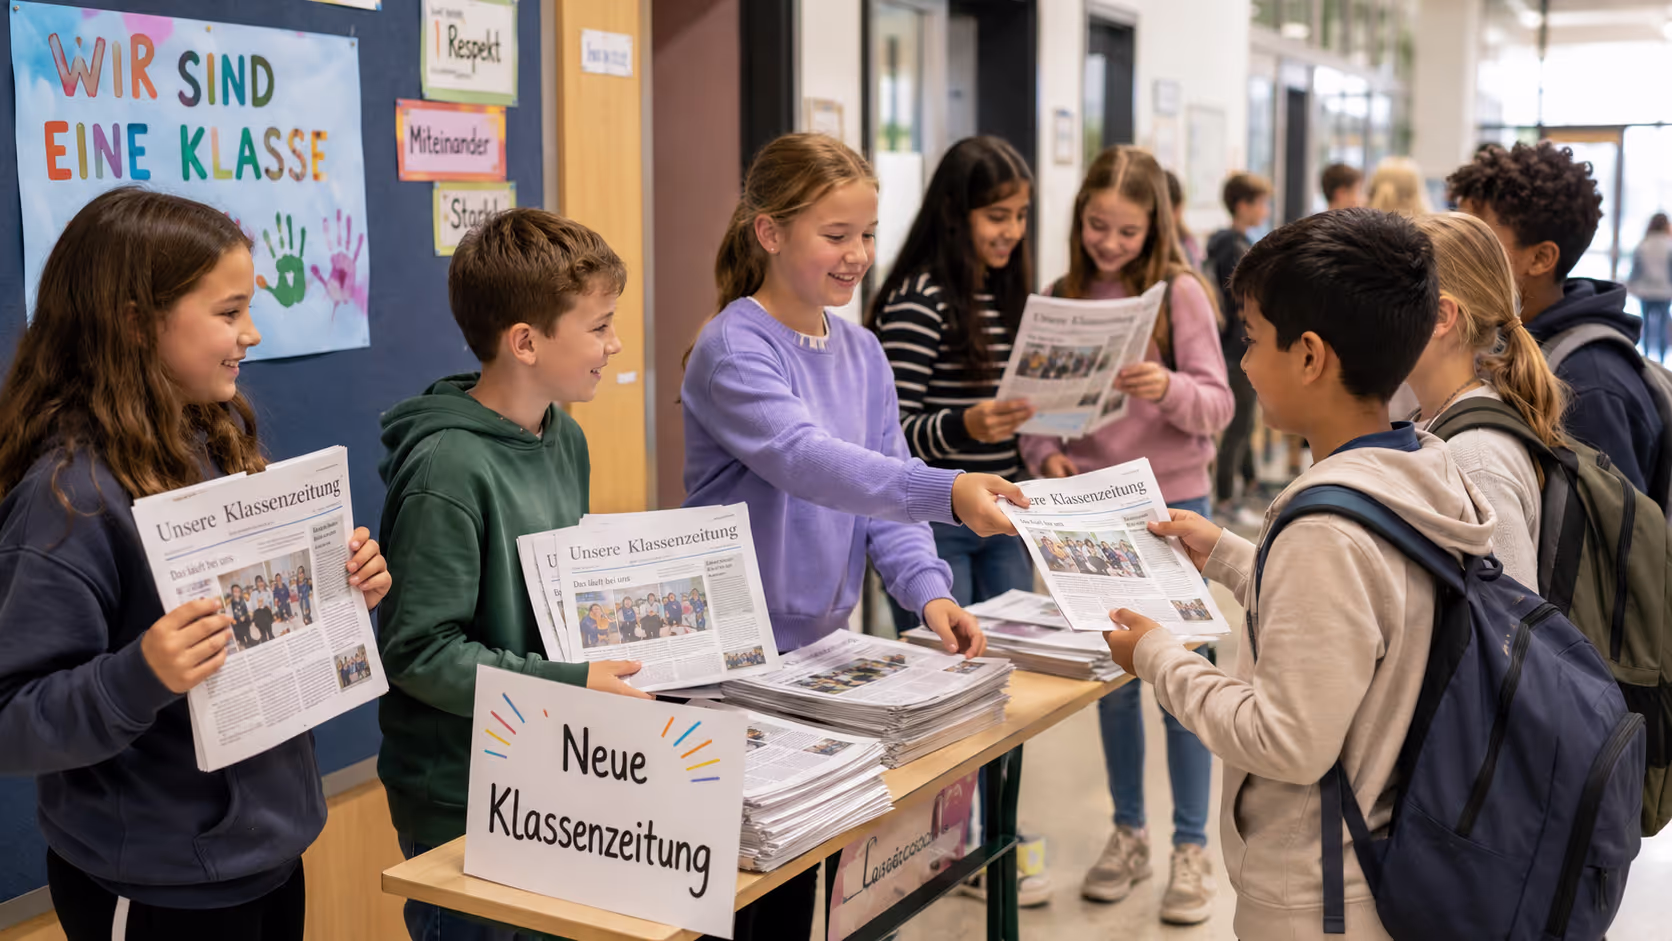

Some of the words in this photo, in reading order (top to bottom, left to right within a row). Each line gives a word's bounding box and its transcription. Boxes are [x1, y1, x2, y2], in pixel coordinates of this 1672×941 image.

[48, 32, 158, 100] WIR
[177, 50, 275, 108] SIND
[447, 24, 501, 73] Respekt
[44, 120, 151, 180] EINE
[180, 123, 328, 182] KLASSE
[409, 125, 490, 156] Miteinander
[156, 514, 217, 542] Unsere
[223, 479, 341, 523] Klassenzeitung
[1049, 480, 1147, 506] Klassenzeitung
[569, 543, 621, 561] Unsere
[627, 524, 739, 555] Klassenzeitung
[605, 576, 616, 584] bei
[562, 722, 649, 785] Neue
[488, 781, 712, 899] Klassenzeitung
